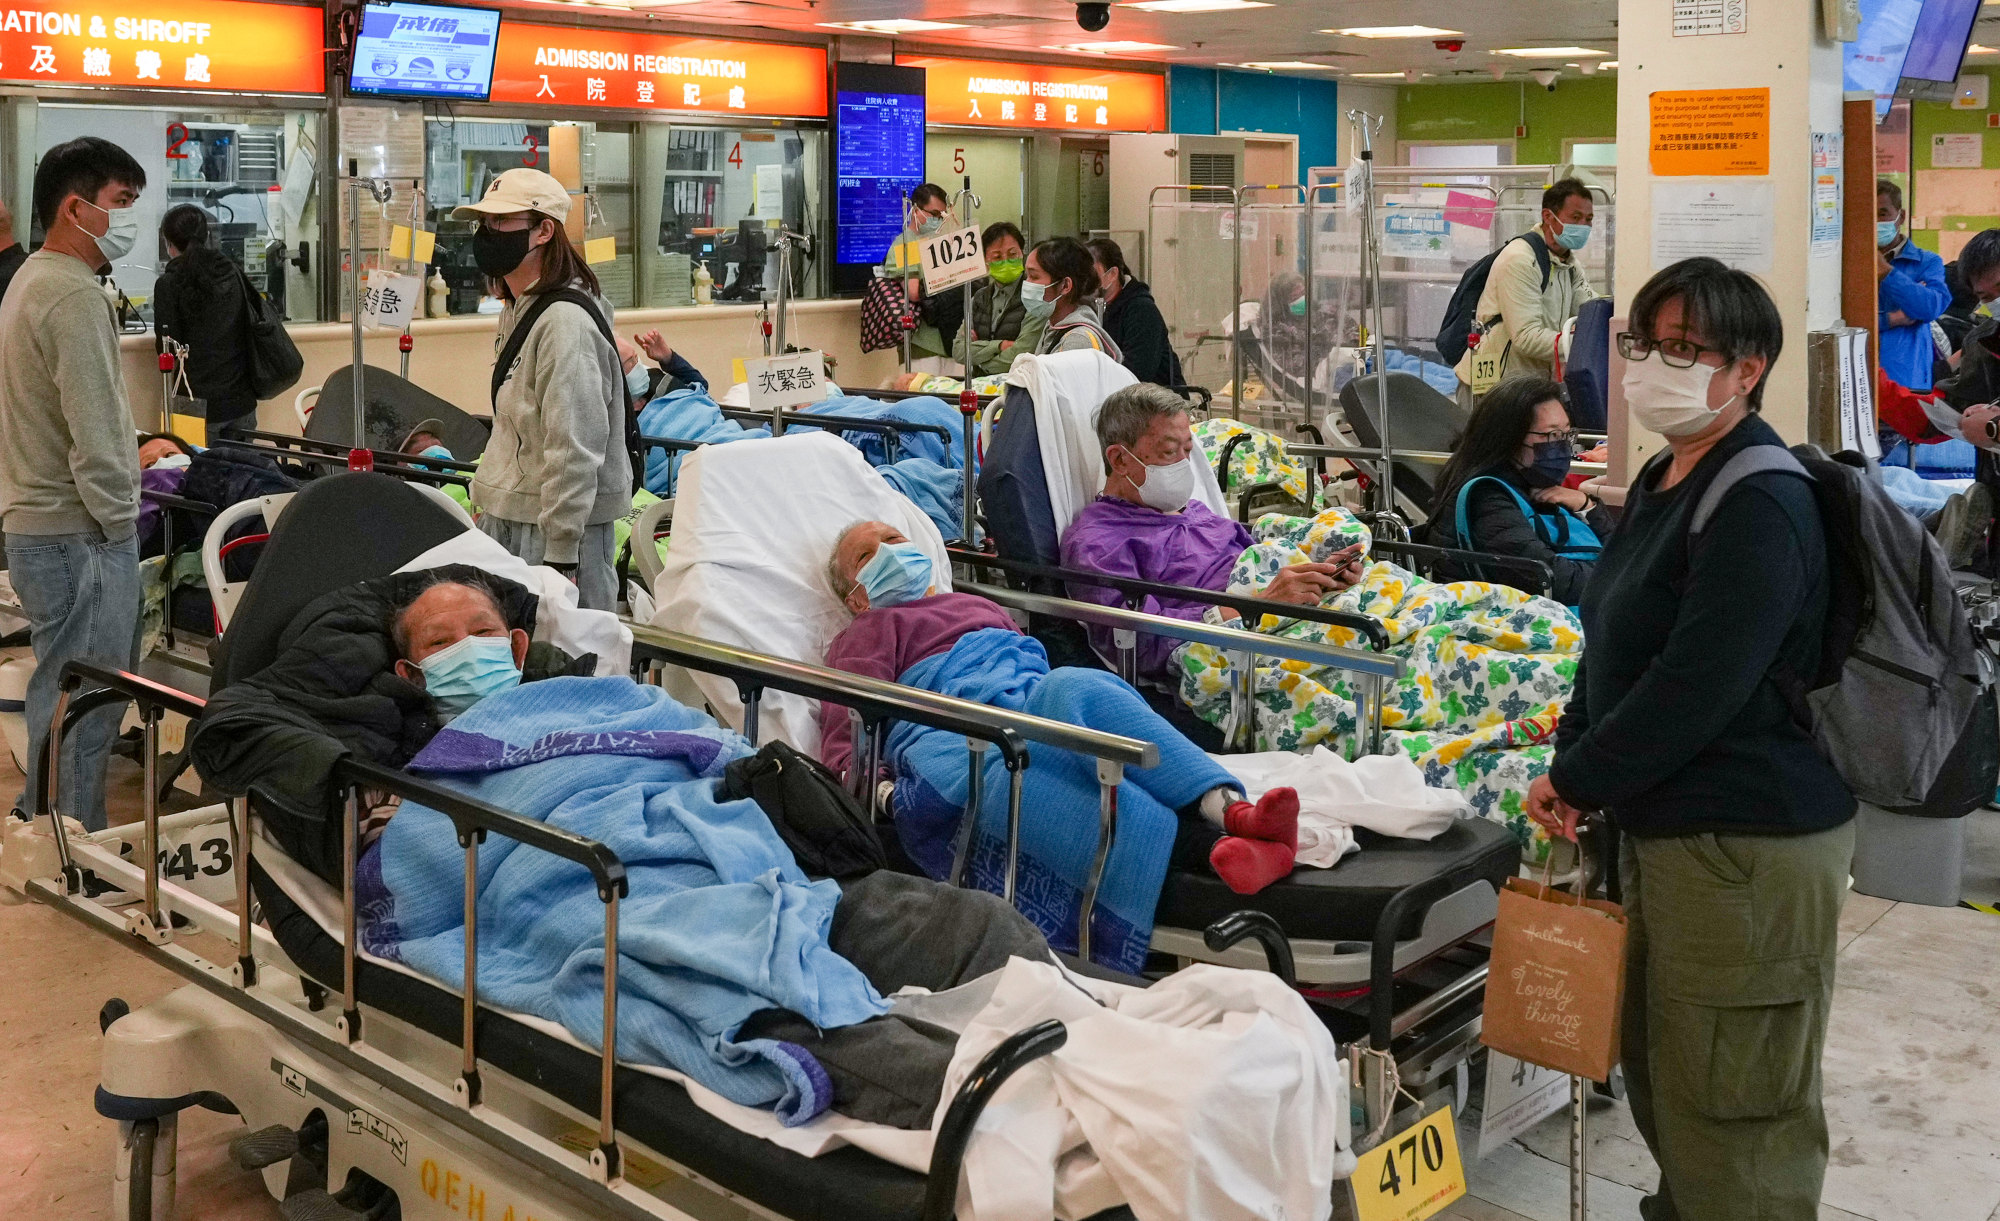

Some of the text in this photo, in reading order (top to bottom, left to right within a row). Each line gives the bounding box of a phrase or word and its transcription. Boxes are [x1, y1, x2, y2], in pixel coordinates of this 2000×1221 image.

[0, 10, 211, 44] ATION & SHROFF
[397, 16, 460, 33] 戒備
[0, 45, 211, 83] 及繳費處
[534, 47, 746, 79] ADMISSION REGISTRATION
[536, 74, 746, 109] 入院登記處
[967, 77, 1108, 101] ADMISSION REGISTRATION
[165, 123, 189, 158] 2
[522, 135, 540, 166] 3
[728, 141, 743, 169] 4
[953, 148, 966, 174] 5
[1093, 151, 1104, 177] 6
[927, 231, 978, 270] 1023
[758, 365, 816, 395] 次緊急
[1476, 360, 1495, 379] 373
[1522, 924, 1590, 953] Hallmark
[1511, 965, 1575, 1011] Lovely
[1525, 1000, 1582, 1044] things
[1379, 1124, 1444, 1197] 470
[421, 1158, 485, 1221] QEH
